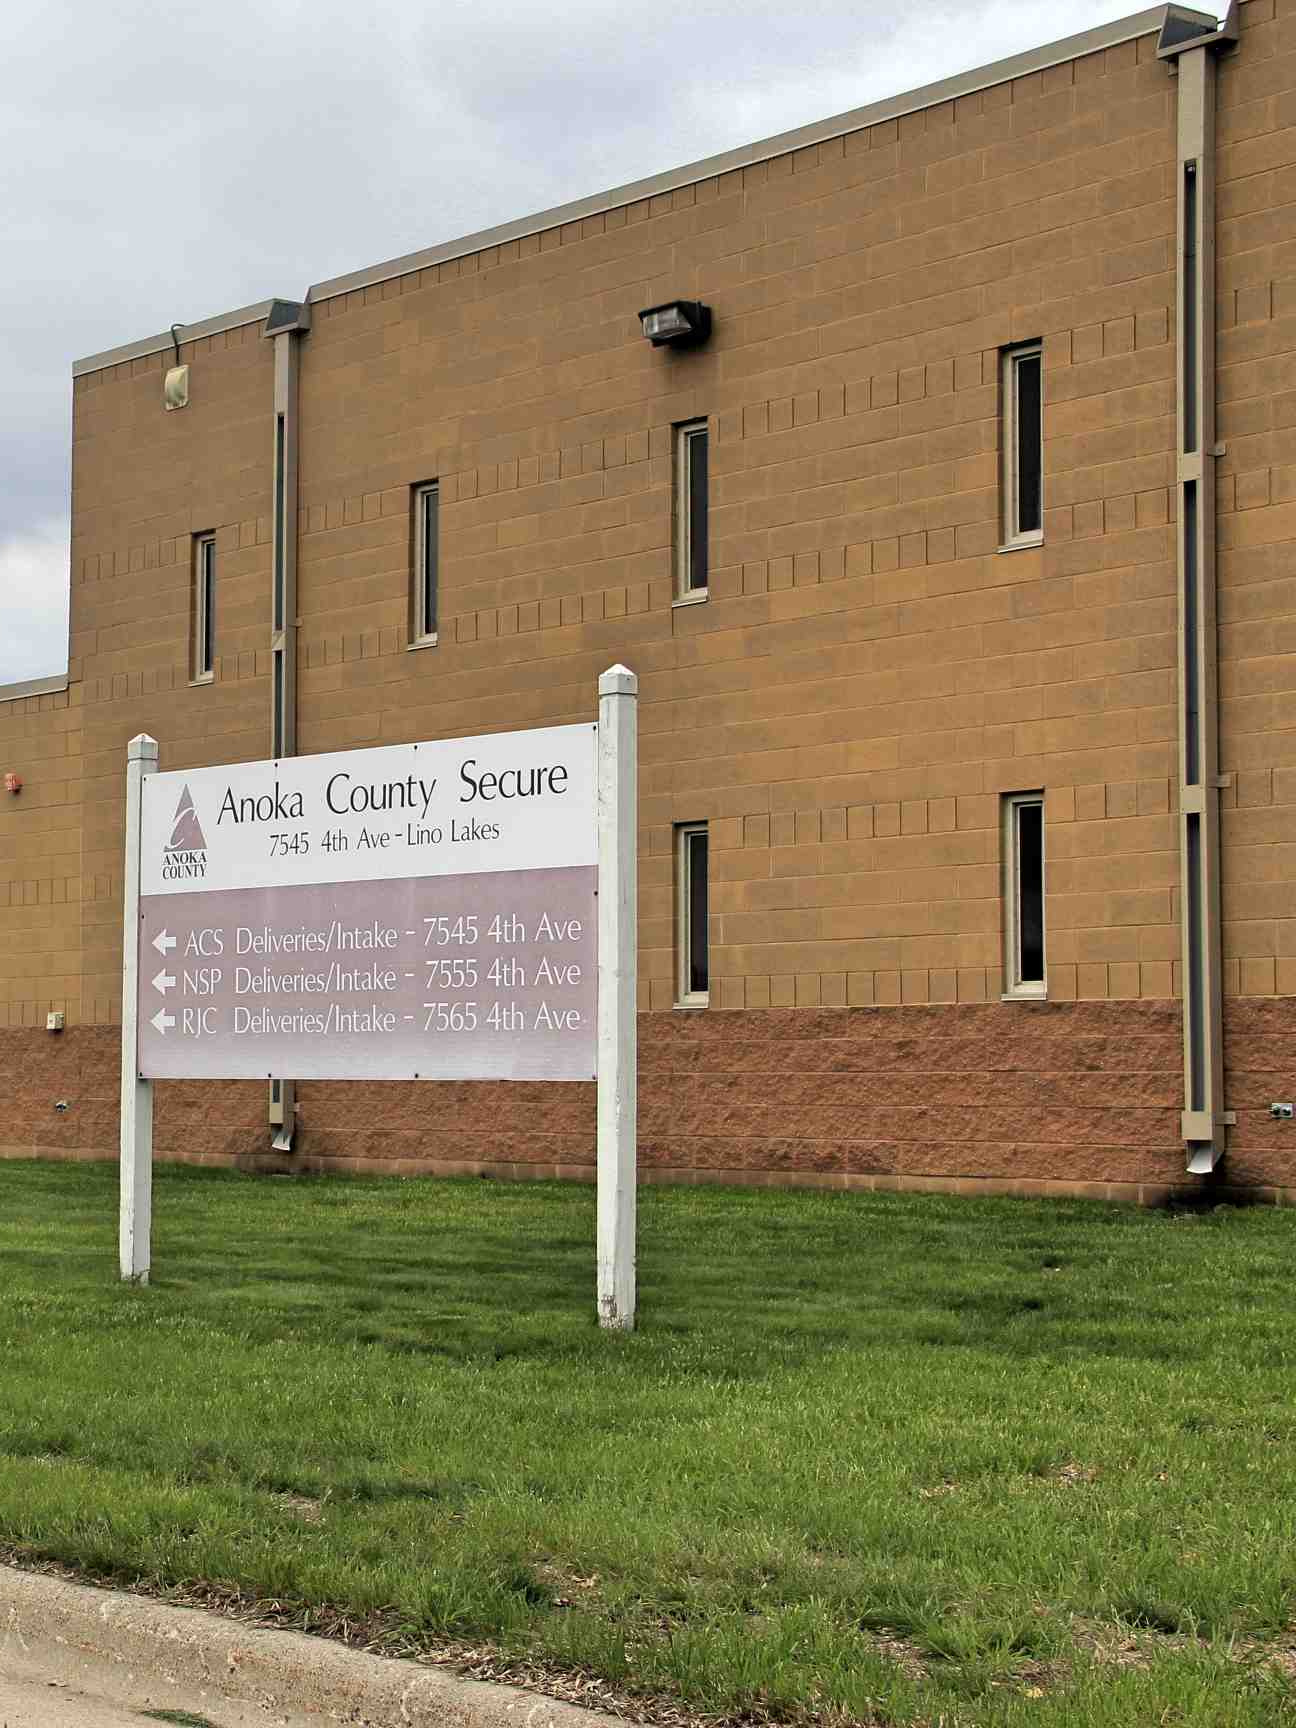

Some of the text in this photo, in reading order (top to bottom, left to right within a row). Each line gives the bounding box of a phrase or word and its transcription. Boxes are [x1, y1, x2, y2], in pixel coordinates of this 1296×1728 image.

[216, 759, 568, 825] Anoka County Secure
[269, 831, 309, 857] 7545
[321, 829, 348, 853] 4th
[451, 817, 500, 842] Lakes
[162, 851, 207, 865] ANOKA
[162, 864, 207, 880] COUNTY
[184, 928, 224, 956] ACS
[236, 920, 400, 954] Deliveries/Intake
[423, 915, 479, 946] 7545
[487, 913, 526, 944] 4th
[534, 911, 582, 942] Ave
[183, 967, 223, 996] NSP
[235, 960, 397, 994] Deliveries/Intake
[424, 959, 478, 989] 7555
[487, 957, 525, 987] 4th
[534, 955, 581, 985] Ave
[182, 1006, 217, 1038] RJC
[234, 1003, 396, 1034] Deliveries/Intake
[423, 1001, 477, 1032] 7565
[486, 1001, 526, 1031] 4th
[534, 1000, 581, 1030] Ave
